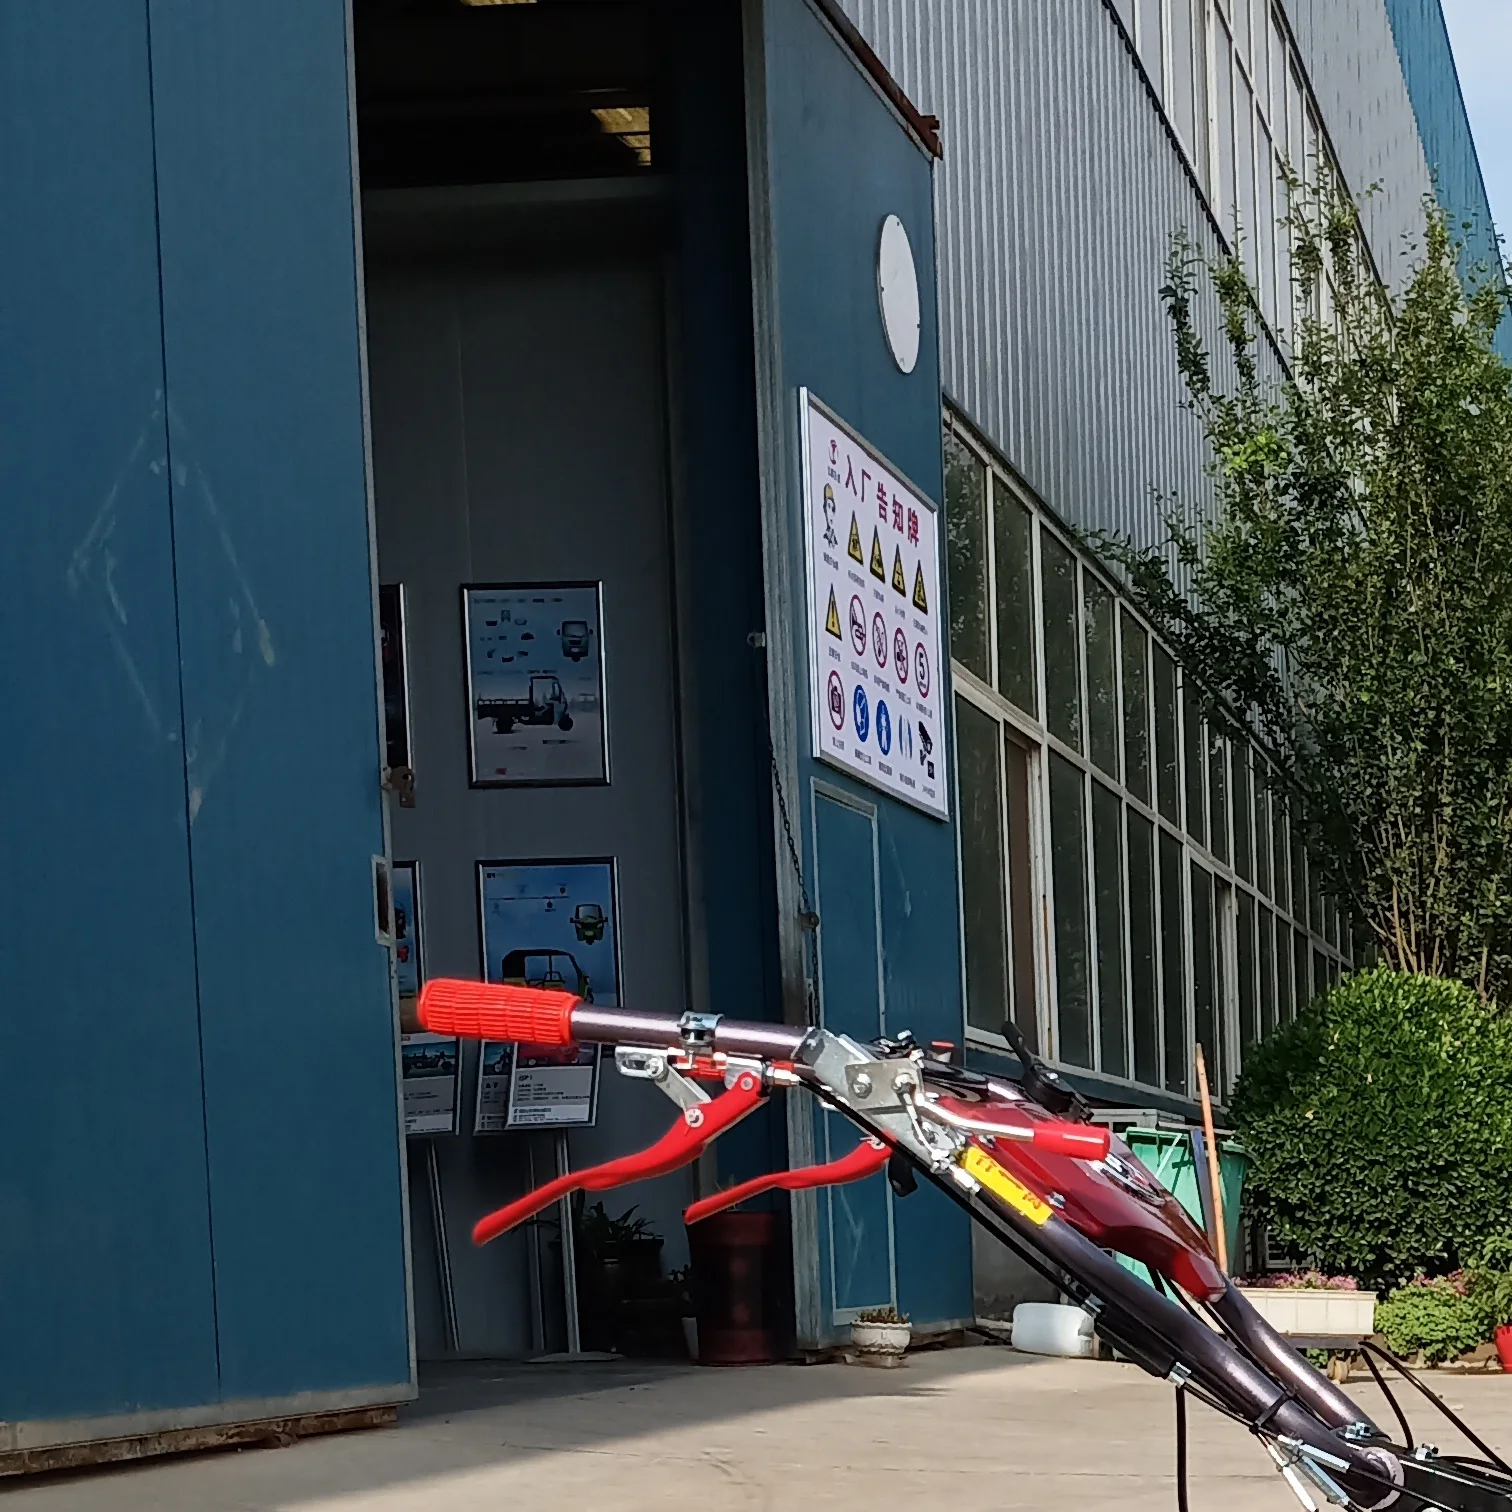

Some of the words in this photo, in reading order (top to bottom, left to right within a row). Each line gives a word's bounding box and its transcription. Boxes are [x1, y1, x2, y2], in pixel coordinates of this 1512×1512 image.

[845, 454, 920, 548] 入厂告知牌
[919, 652, 925, 680] 5
